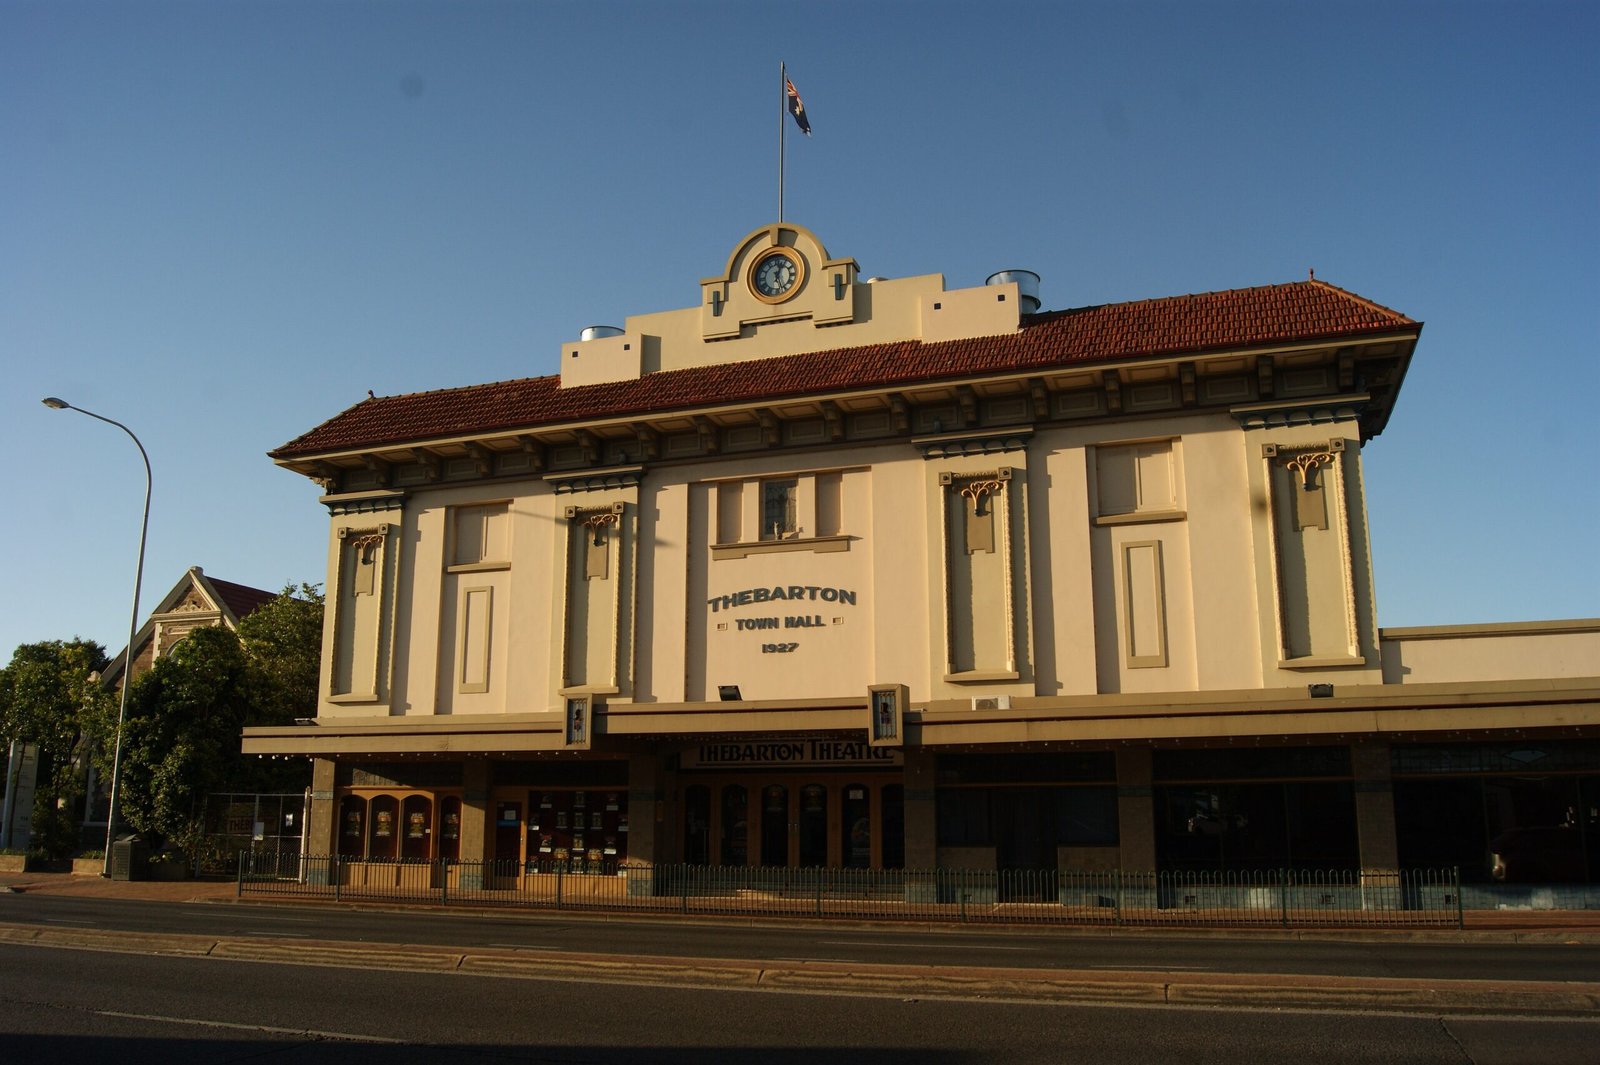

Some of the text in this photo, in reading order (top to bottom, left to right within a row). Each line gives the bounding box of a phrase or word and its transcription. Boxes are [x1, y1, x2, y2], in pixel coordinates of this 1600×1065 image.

[707, 585, 856, 613] THEBARTON
[735, 615, 826, 631] TOWN HALL
[762, 642, 800, 654] 1927
[700, 738, 895, 762] THEBARTON THEATRE
